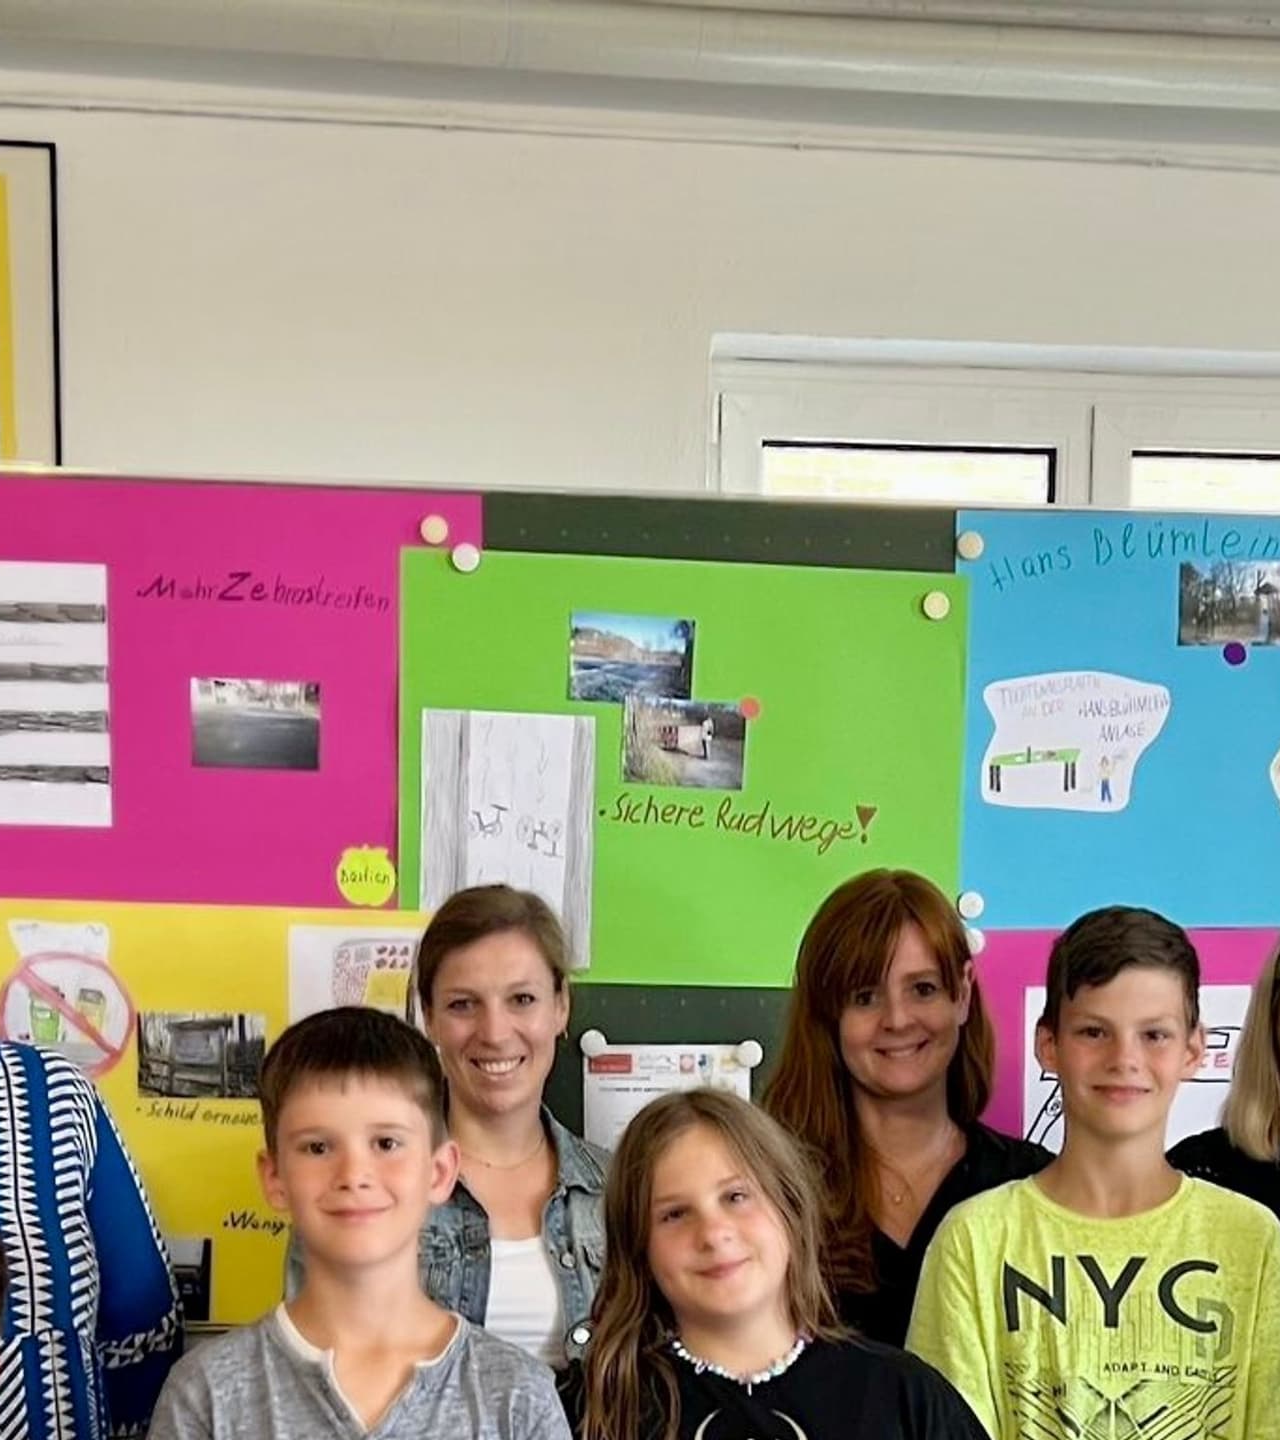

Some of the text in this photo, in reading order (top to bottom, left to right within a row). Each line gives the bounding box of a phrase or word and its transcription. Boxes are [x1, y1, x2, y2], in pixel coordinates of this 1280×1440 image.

[989, 546, 1072, 592] Hans
[612, 794, 706, 829] Sichere
[147, 1100, 261, 1127] Schild erneue
[1003, 1254, 1220, 1333] NYC
[1153, 1362, 1181, 1377] AND
